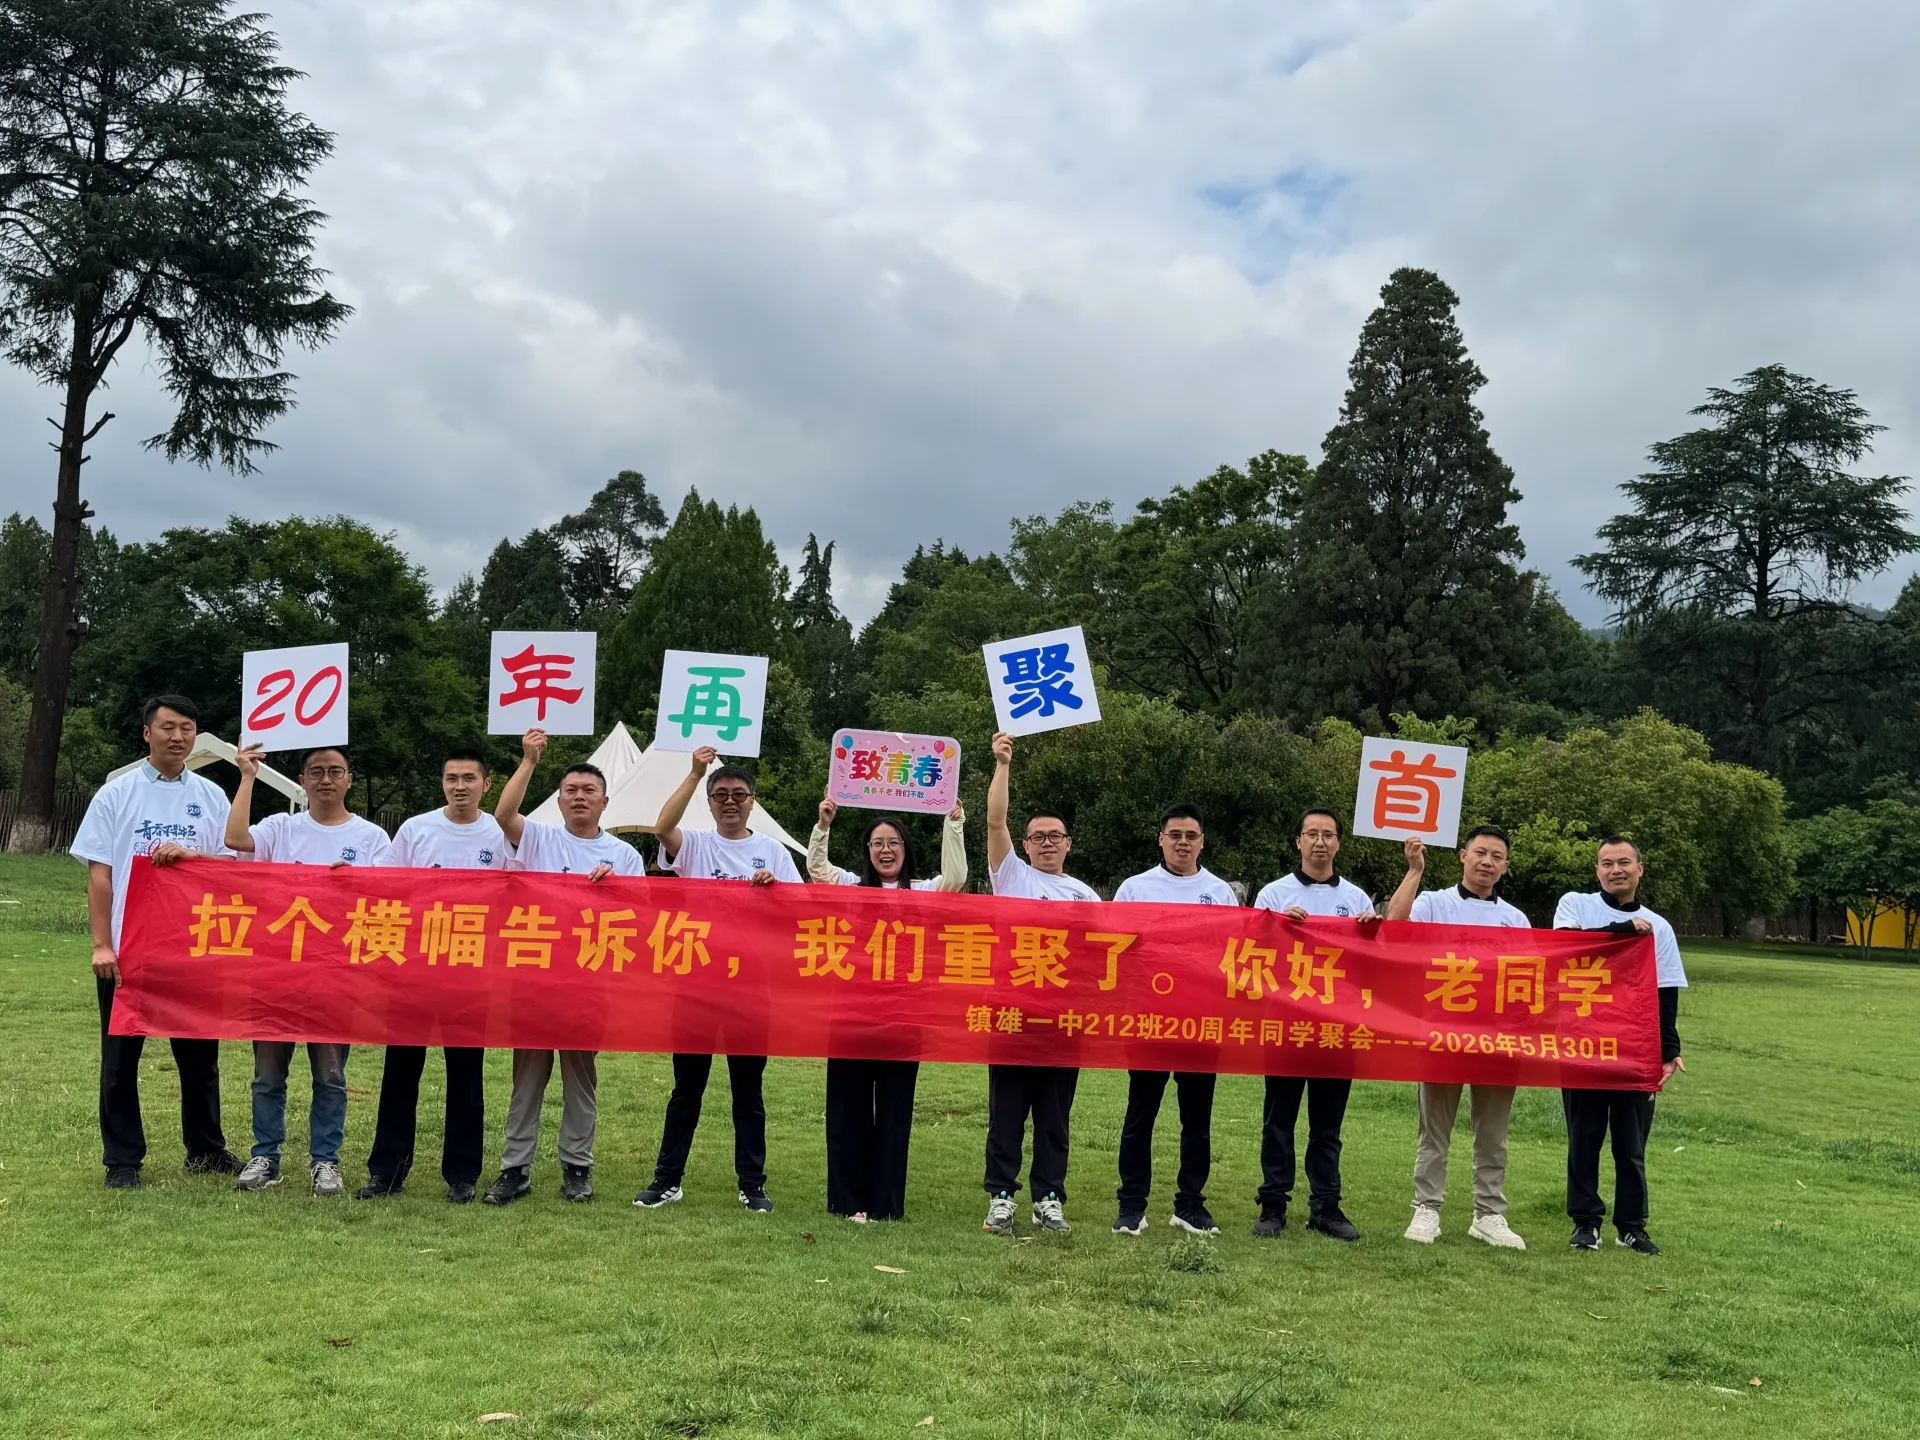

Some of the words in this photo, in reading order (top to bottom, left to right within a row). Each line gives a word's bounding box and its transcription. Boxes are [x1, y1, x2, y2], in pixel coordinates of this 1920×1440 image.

[247, 665, 342, 731] 20
[499, 643, 584, 721] 年
[667, 666, 753, 742] 再
[999, 643, 1083, 719] 聚
[849, 750, 943, 788] 致青春
[1369, 750, 1457, 833] 首
